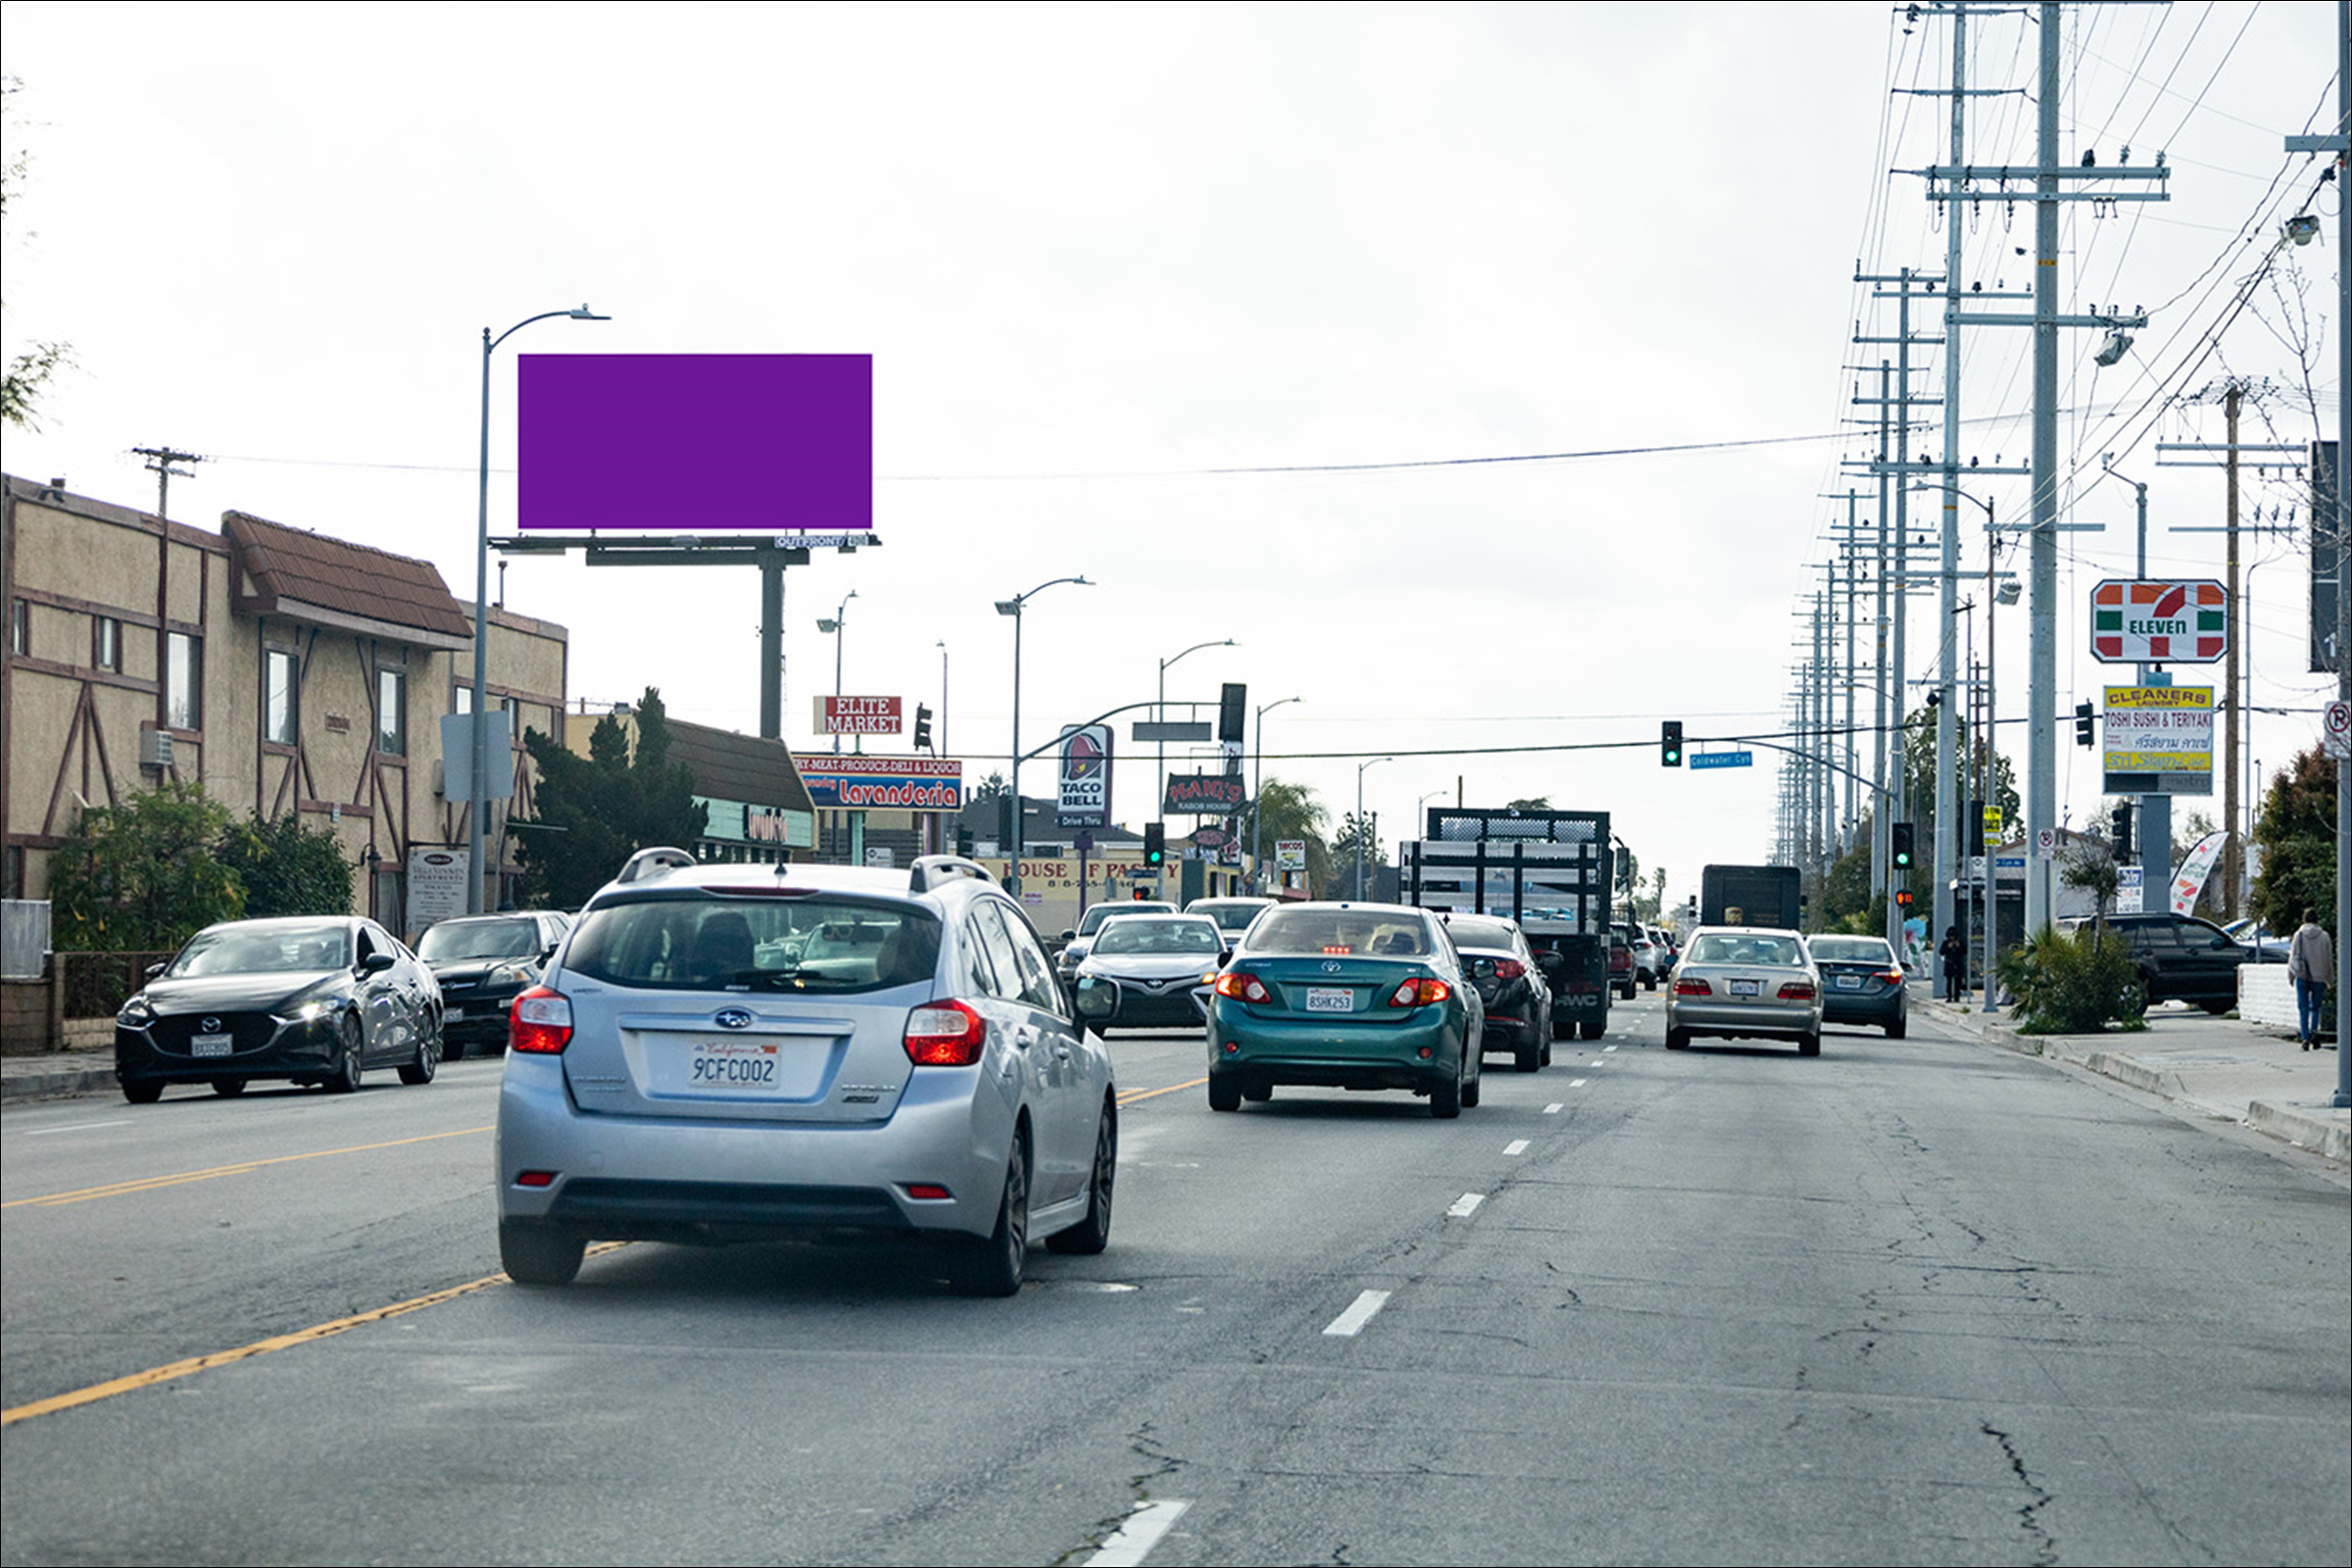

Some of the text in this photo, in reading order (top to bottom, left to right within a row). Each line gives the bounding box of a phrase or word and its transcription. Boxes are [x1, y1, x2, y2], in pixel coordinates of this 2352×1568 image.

[2109, 689, 2206, 705] CLEANERS
[836, 698, 890, 715] ELITE
[827, 715, 900, 733] MARKET
[2105, 712, 2212, 727] TOSHI SUSHI & TERIYAKI
[914, 761, 921, 772] &
[923, 761, 960, 775] LIQUOR
[1690, 755, 1733, 766] Coldwater
[804, 776, 957, 806] aundry Lavanderia
[1061, 783, 1102, 793] TACO
[1170, 780, 1242, 803] HAIG'S
[1062, 795, 1102, 806] BELL
[1062, 815, 1083, 826] Drive
[708, 1042, 763, 1057] California
[694, 1057, 774, 1082] 9CFC002
